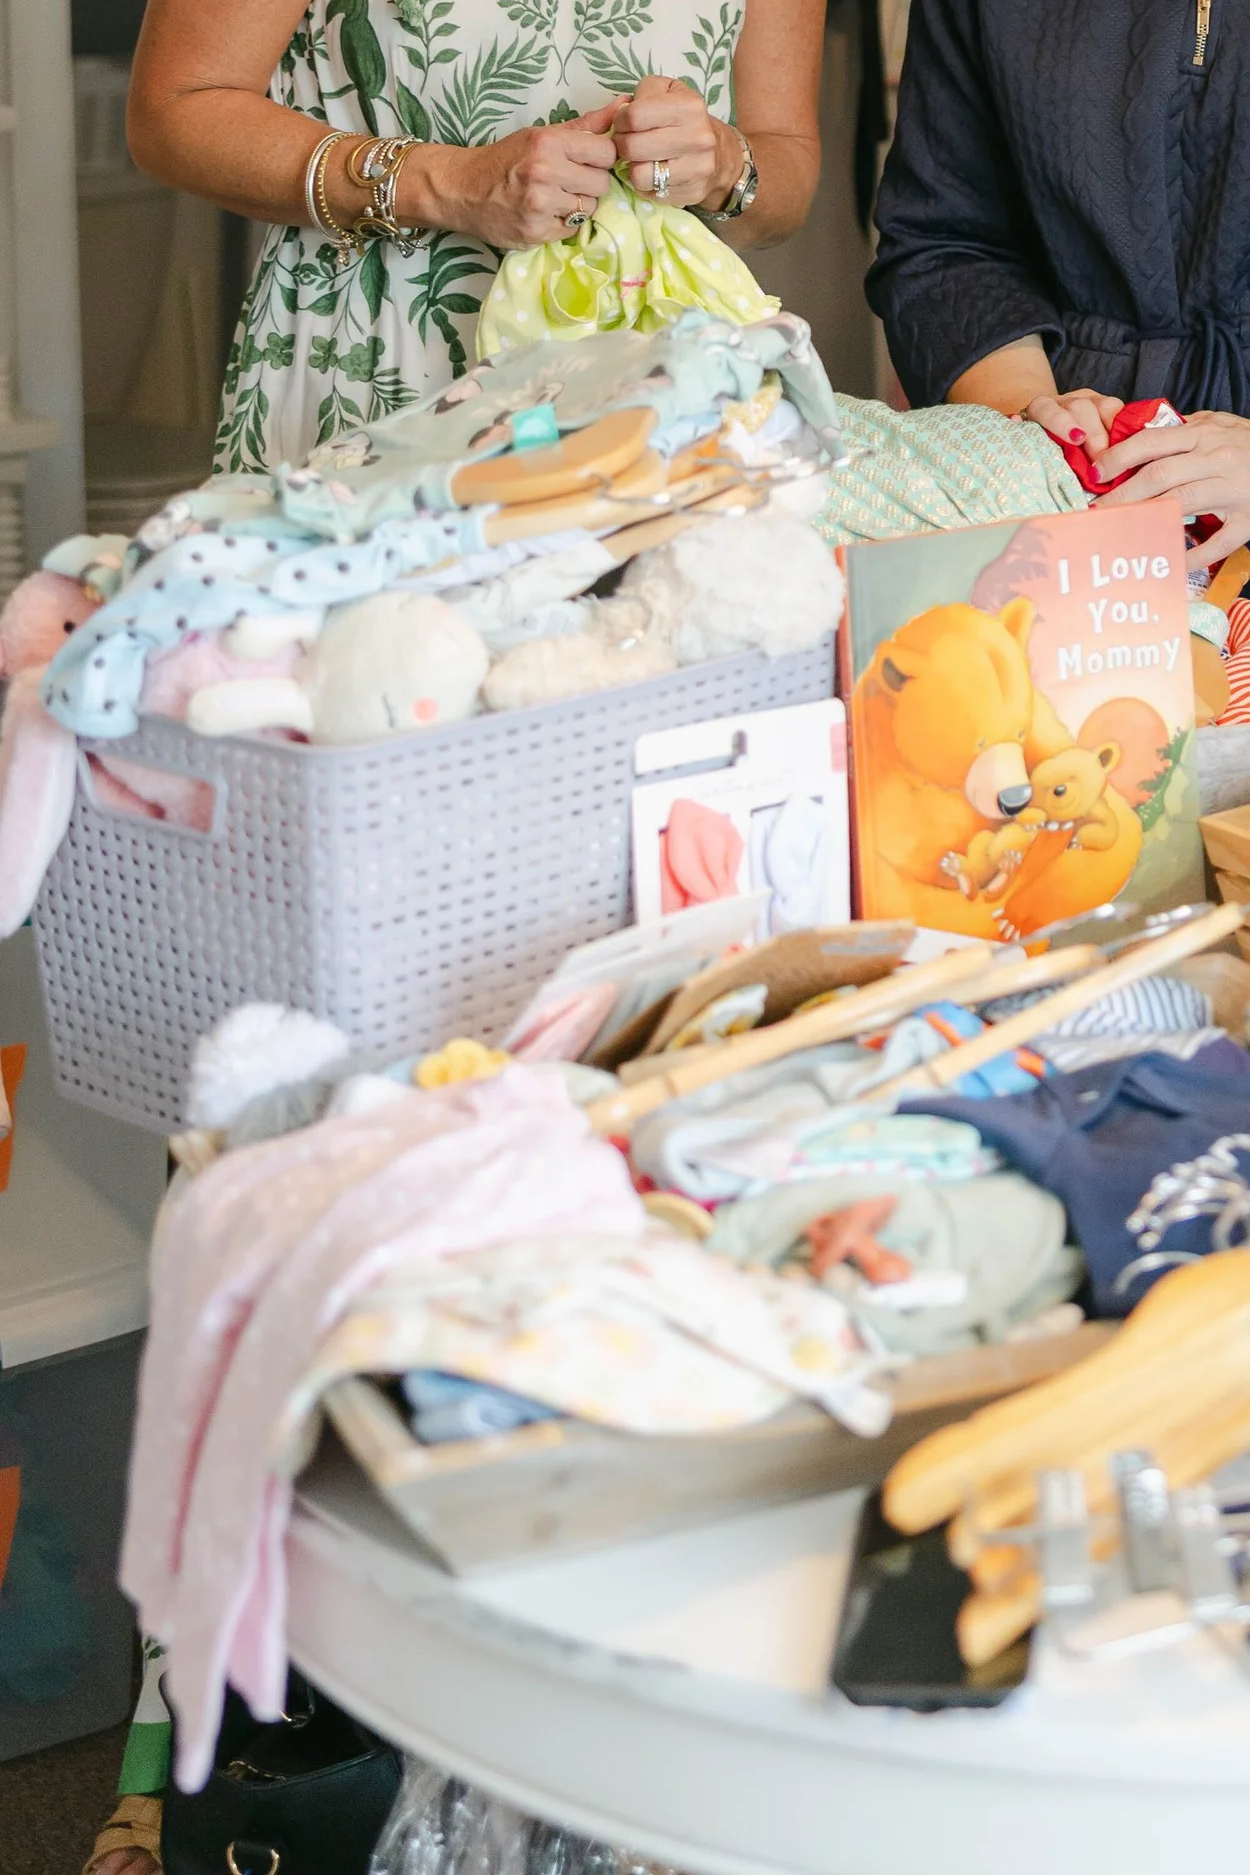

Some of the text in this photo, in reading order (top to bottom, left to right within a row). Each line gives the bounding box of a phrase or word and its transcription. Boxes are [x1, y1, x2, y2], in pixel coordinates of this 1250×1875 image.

[1058, 558, 1070, 595] I
[1091, 554, 1170, 588] Love
[1056, 636, 1181, 681] Mommy
